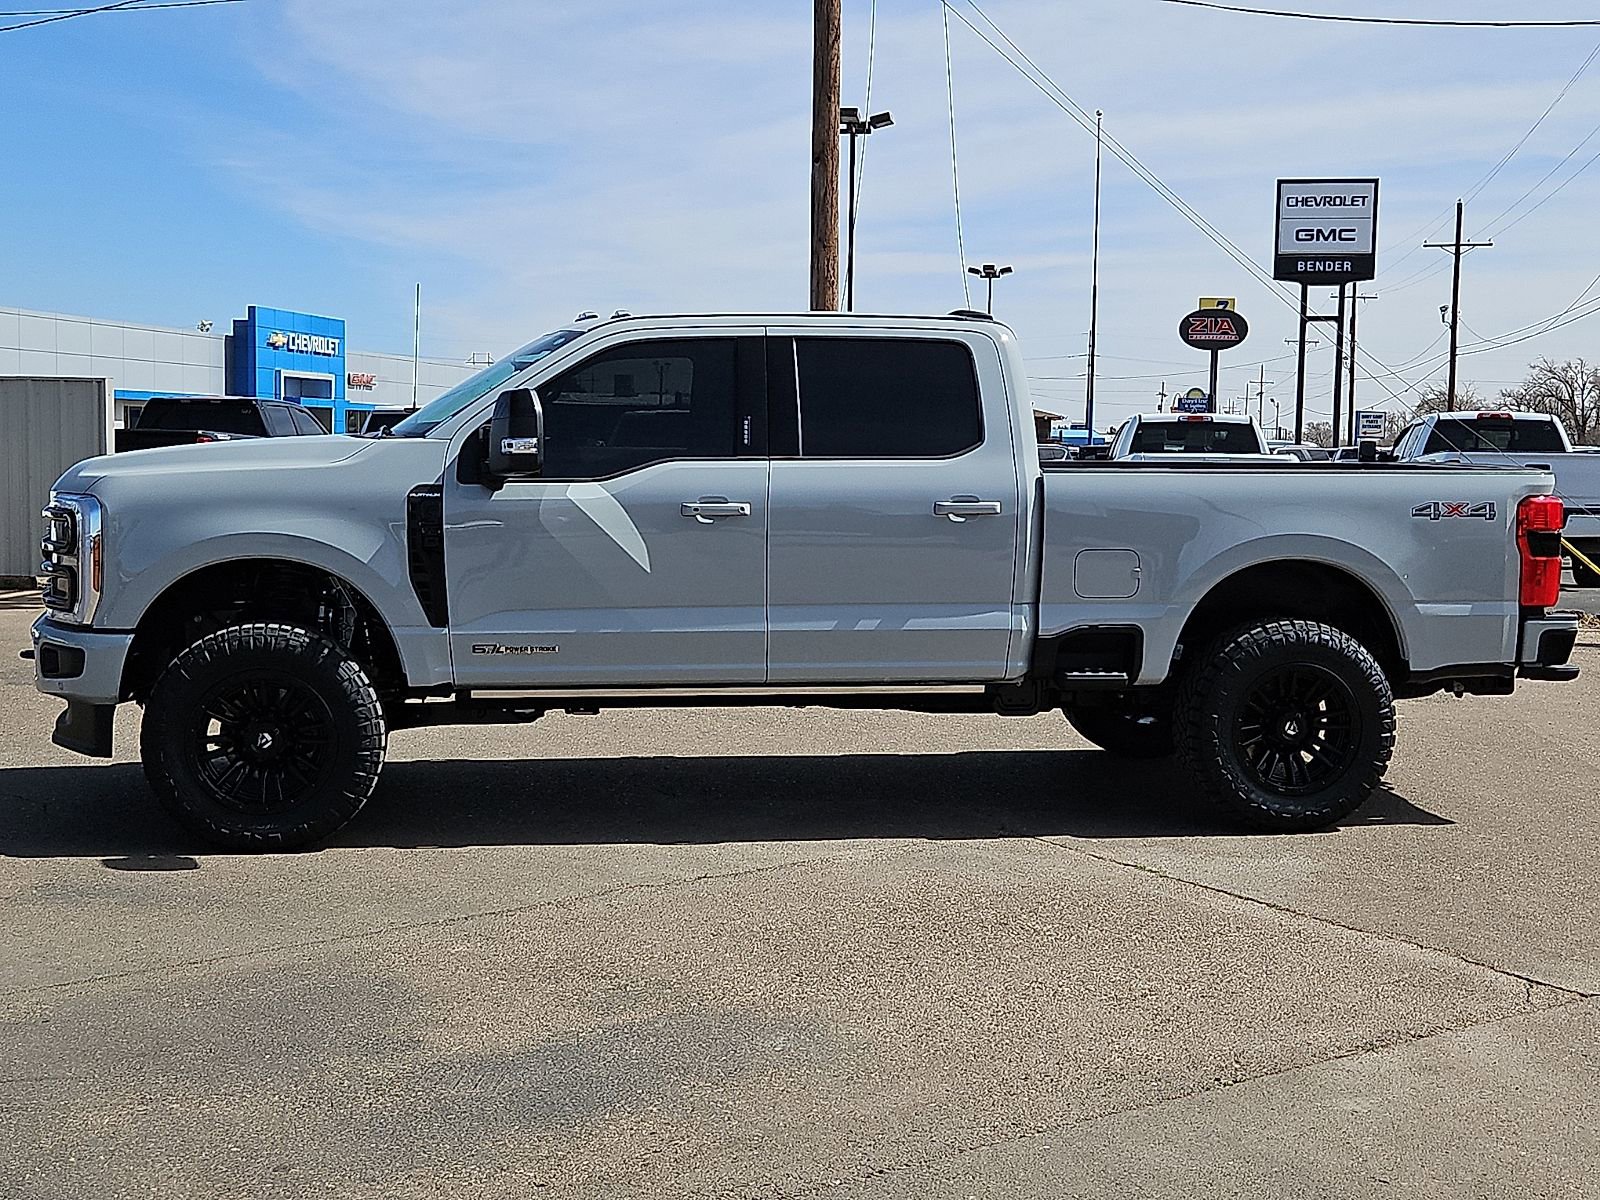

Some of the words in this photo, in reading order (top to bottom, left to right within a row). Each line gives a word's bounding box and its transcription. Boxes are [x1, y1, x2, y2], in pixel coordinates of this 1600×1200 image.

[1286, 195, 1369, 208] CHEVROLET
[1295, 228, 1357, 242] GMC
[1297, 261, 1352, 272] BENDER
[1188, 317, 1237, 334] ZIA
[288, 332, 340, 355] CHEVROLET
[351, 373, 376, 386] GMC
[504, 646, 529, 654] POWER
[530, 645, 559, 654] STROKE
